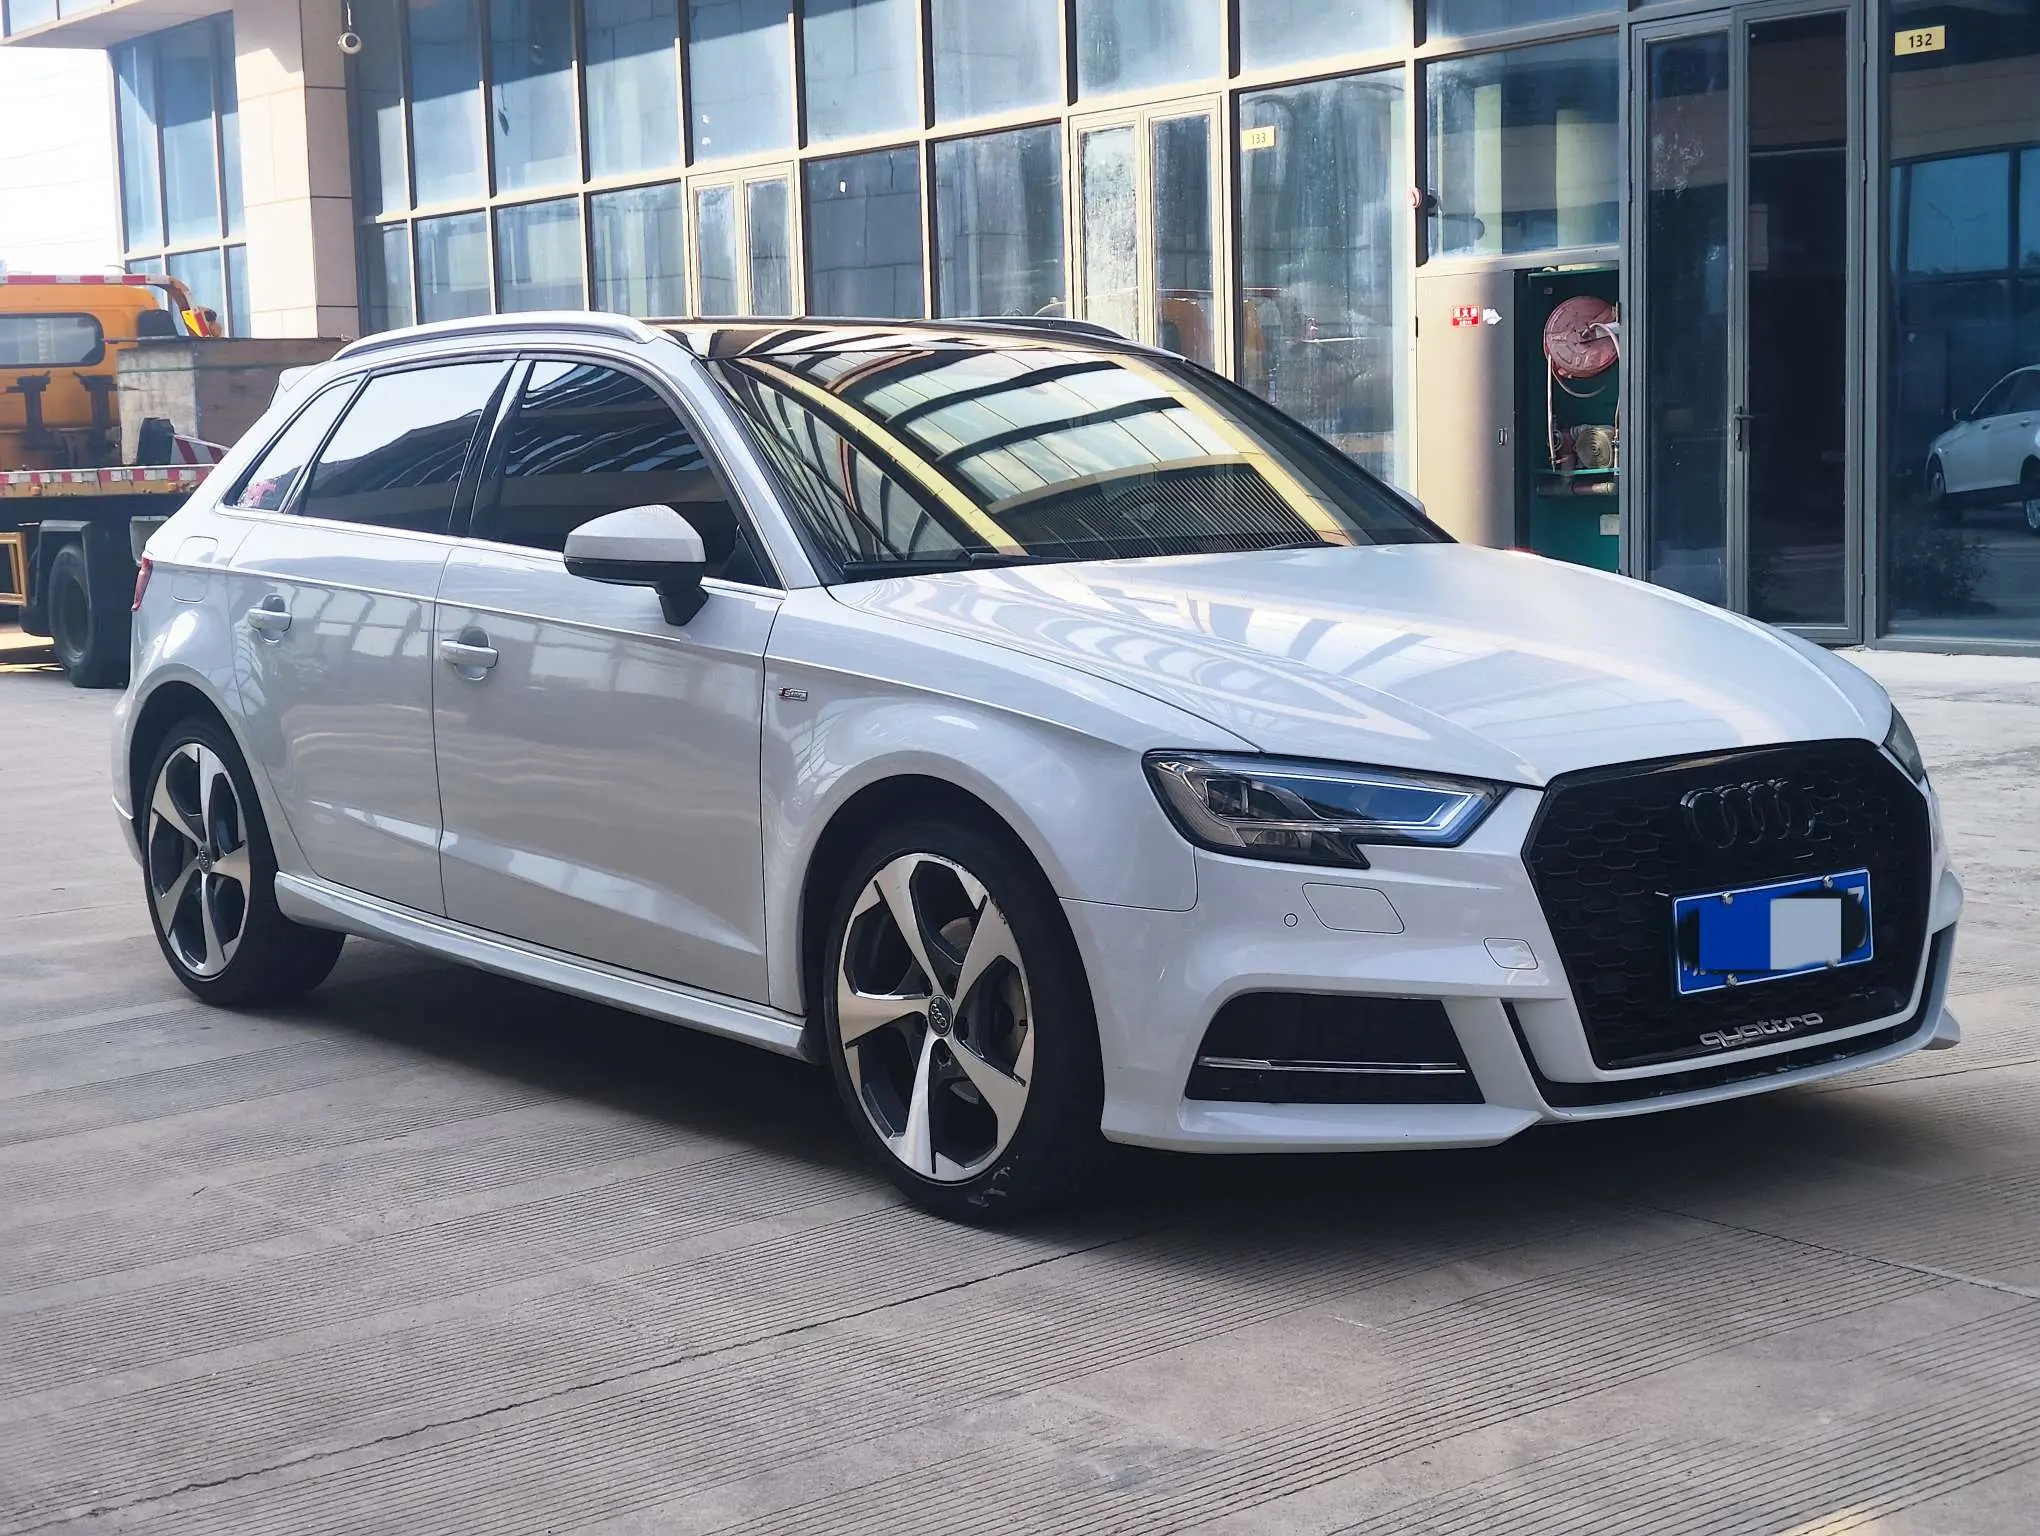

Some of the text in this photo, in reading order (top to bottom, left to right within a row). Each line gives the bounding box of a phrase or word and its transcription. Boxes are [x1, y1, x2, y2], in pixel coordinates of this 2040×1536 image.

[1909, 33, 1933, 48] 132
[1252, 132, 1266, 145] 133
[1700, 1012, 1824, 1048] quattro
